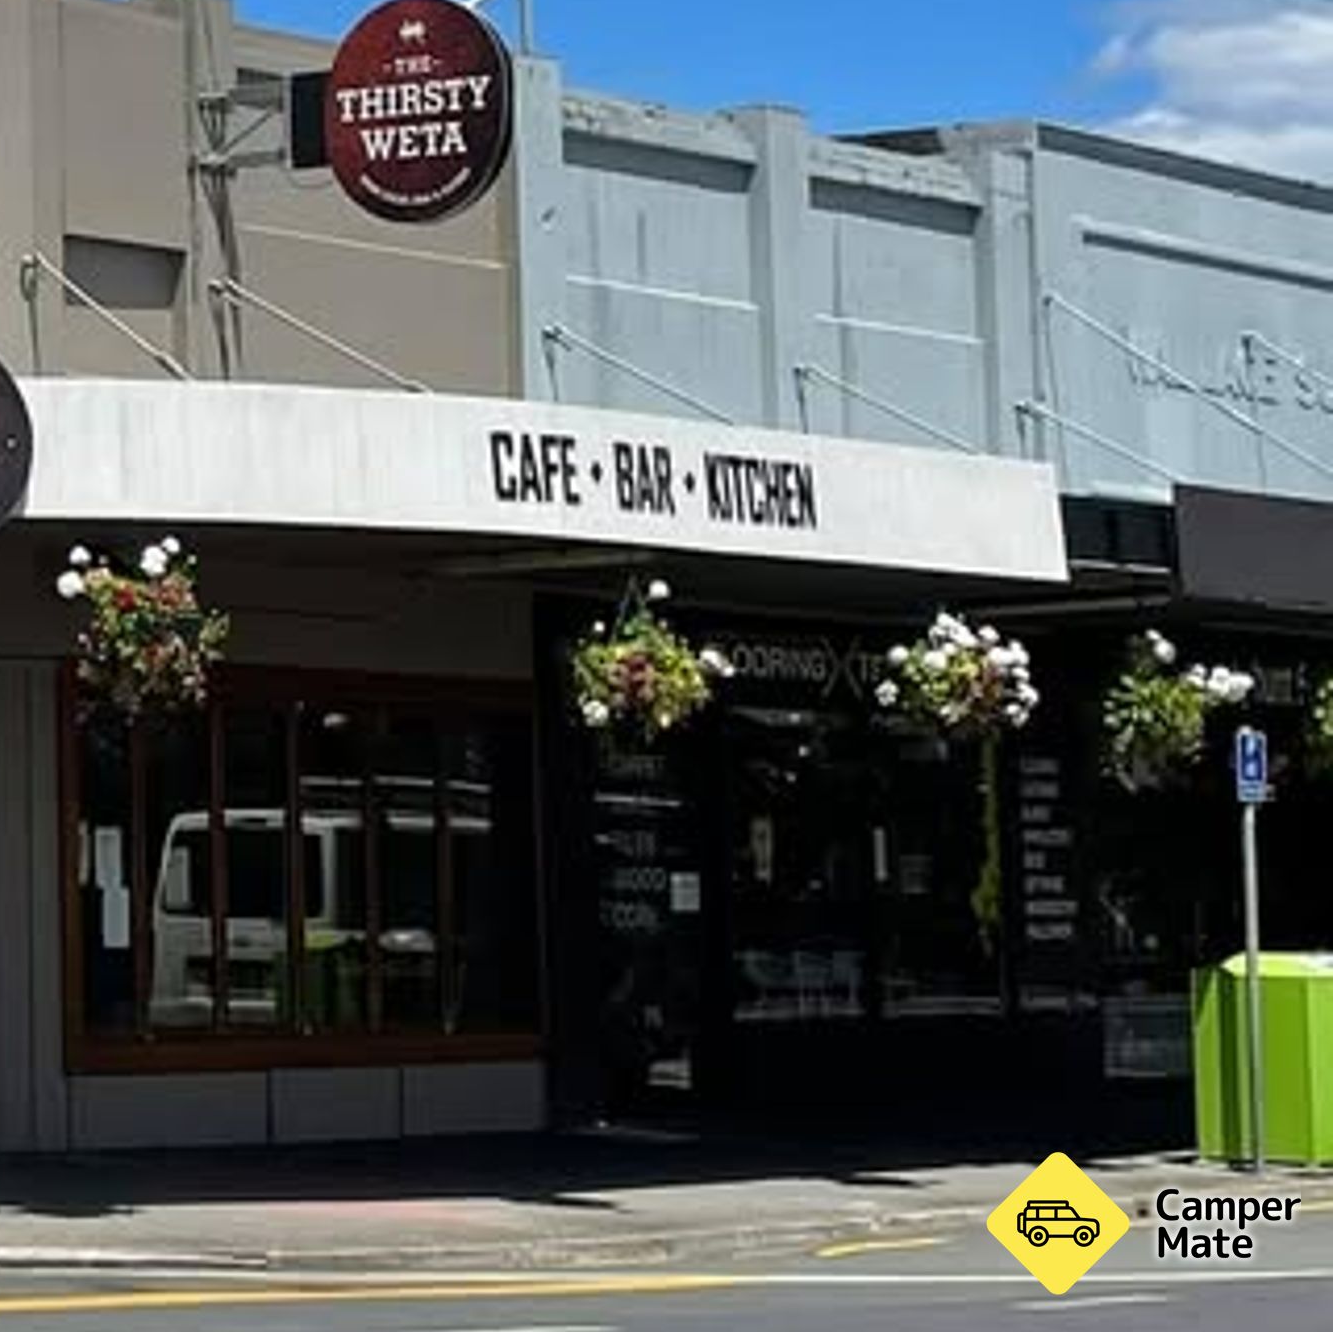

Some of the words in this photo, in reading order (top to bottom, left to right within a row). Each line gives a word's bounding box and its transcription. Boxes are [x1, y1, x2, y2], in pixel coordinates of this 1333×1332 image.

[395, 56, 432, 74] THE
[337, 76, 491, 122] THIRSTY
[361, 122, 467, 161] WETA
[490, 432, 581, 505] CAFE
[613, 442, 676, 516] BAR
[703, 452, 817, 529] KITCHEN
